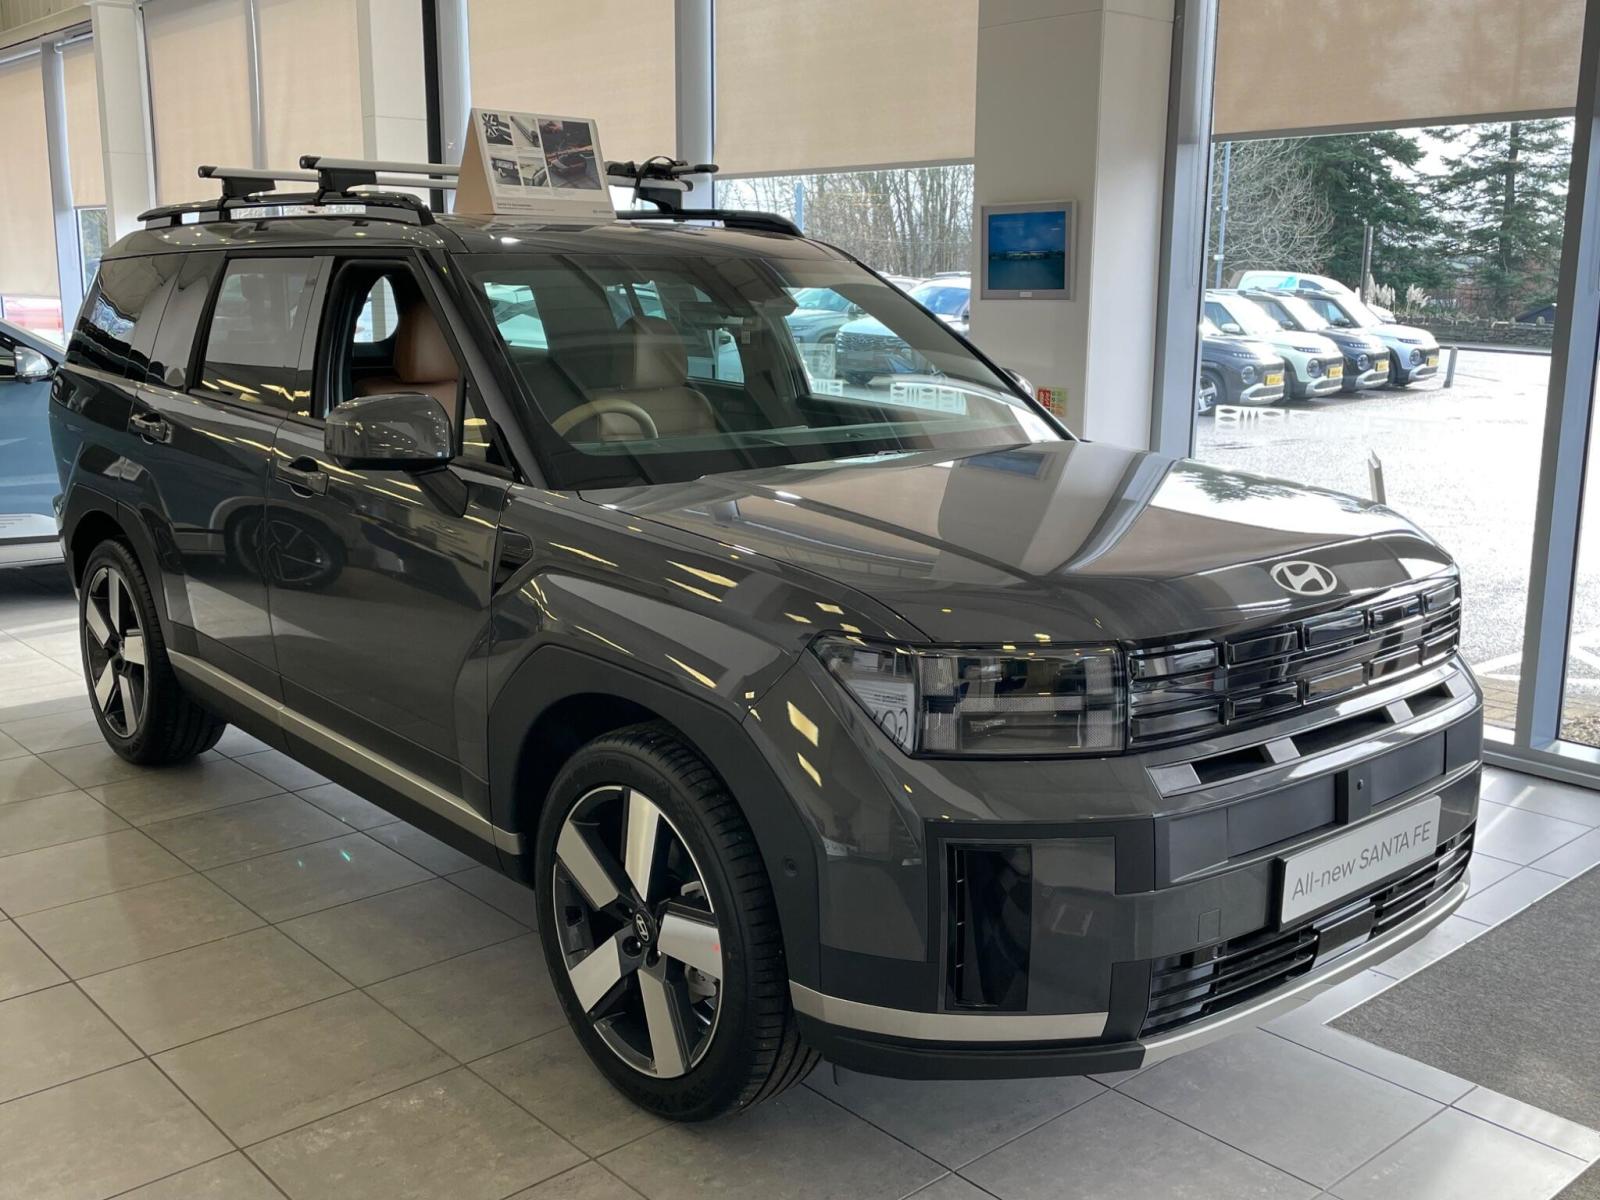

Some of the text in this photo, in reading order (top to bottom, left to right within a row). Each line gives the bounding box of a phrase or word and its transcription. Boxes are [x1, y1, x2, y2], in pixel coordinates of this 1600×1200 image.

[1292, 821, 1431, 900] All-new SANTA FE
